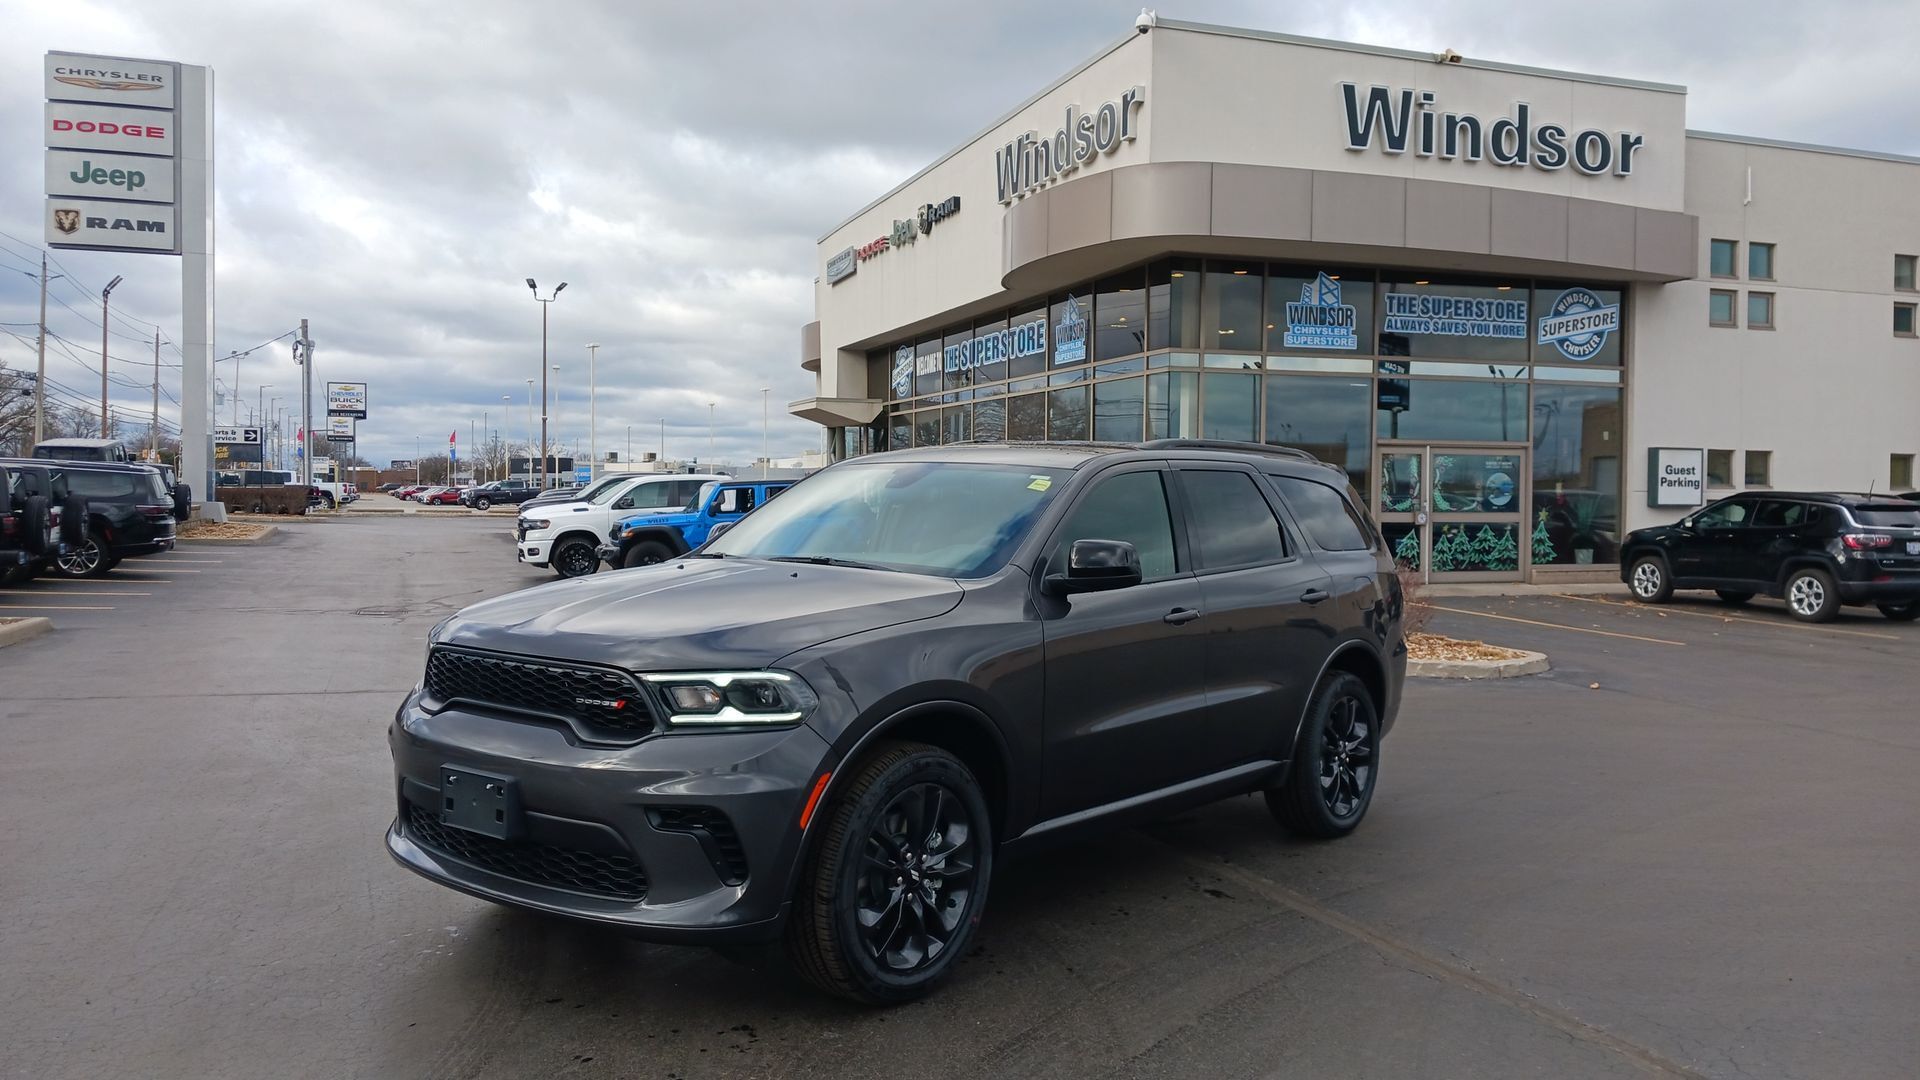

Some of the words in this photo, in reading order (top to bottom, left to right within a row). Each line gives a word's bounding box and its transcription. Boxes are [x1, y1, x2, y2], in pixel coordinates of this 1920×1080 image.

[55, 67, 163, 82] CHRYSLER
[53, 119, 165, 138] DODGE
[1338, 81, 1643, 176] Windsor
[995, 85, 1144, 205] Windsor
[70, 161, 145, 191] Jeep
[927, 196, 960, 223] RAM
[86, 217, 165, 233] RAM
[1386, 295, 1418, 315] THE
[1420, 296, 1526, 321] SUPERSTORE
[1557, 293, 1595, 312] WINDSOR
[1288, 305, 1353, 327] WINDSOR
[1542, 312, 1616, 337] SUPERSTORE
[1294, 326, 1348, 336] CHRYSLER
[1387, 318, 1430, 332] ALWAYS
[1432, 320, 1467, 334] SAVES
[1470, 322, 1490, 335] YOU
[1492, 323, 1525, 337] MORE!
[945, 347, 958, 371] THE
[961, 322, 1045, 369] SUPERSTORE
[1287, 335, 1354, 346] SUPERSTORE
[1563, 335, 1601, 356] CHRYSLER
[1665, 464, 1696, 475] Guest
[1660, 477, 1700, 490] Parking
[575, 697, 618, 707] DODGE
